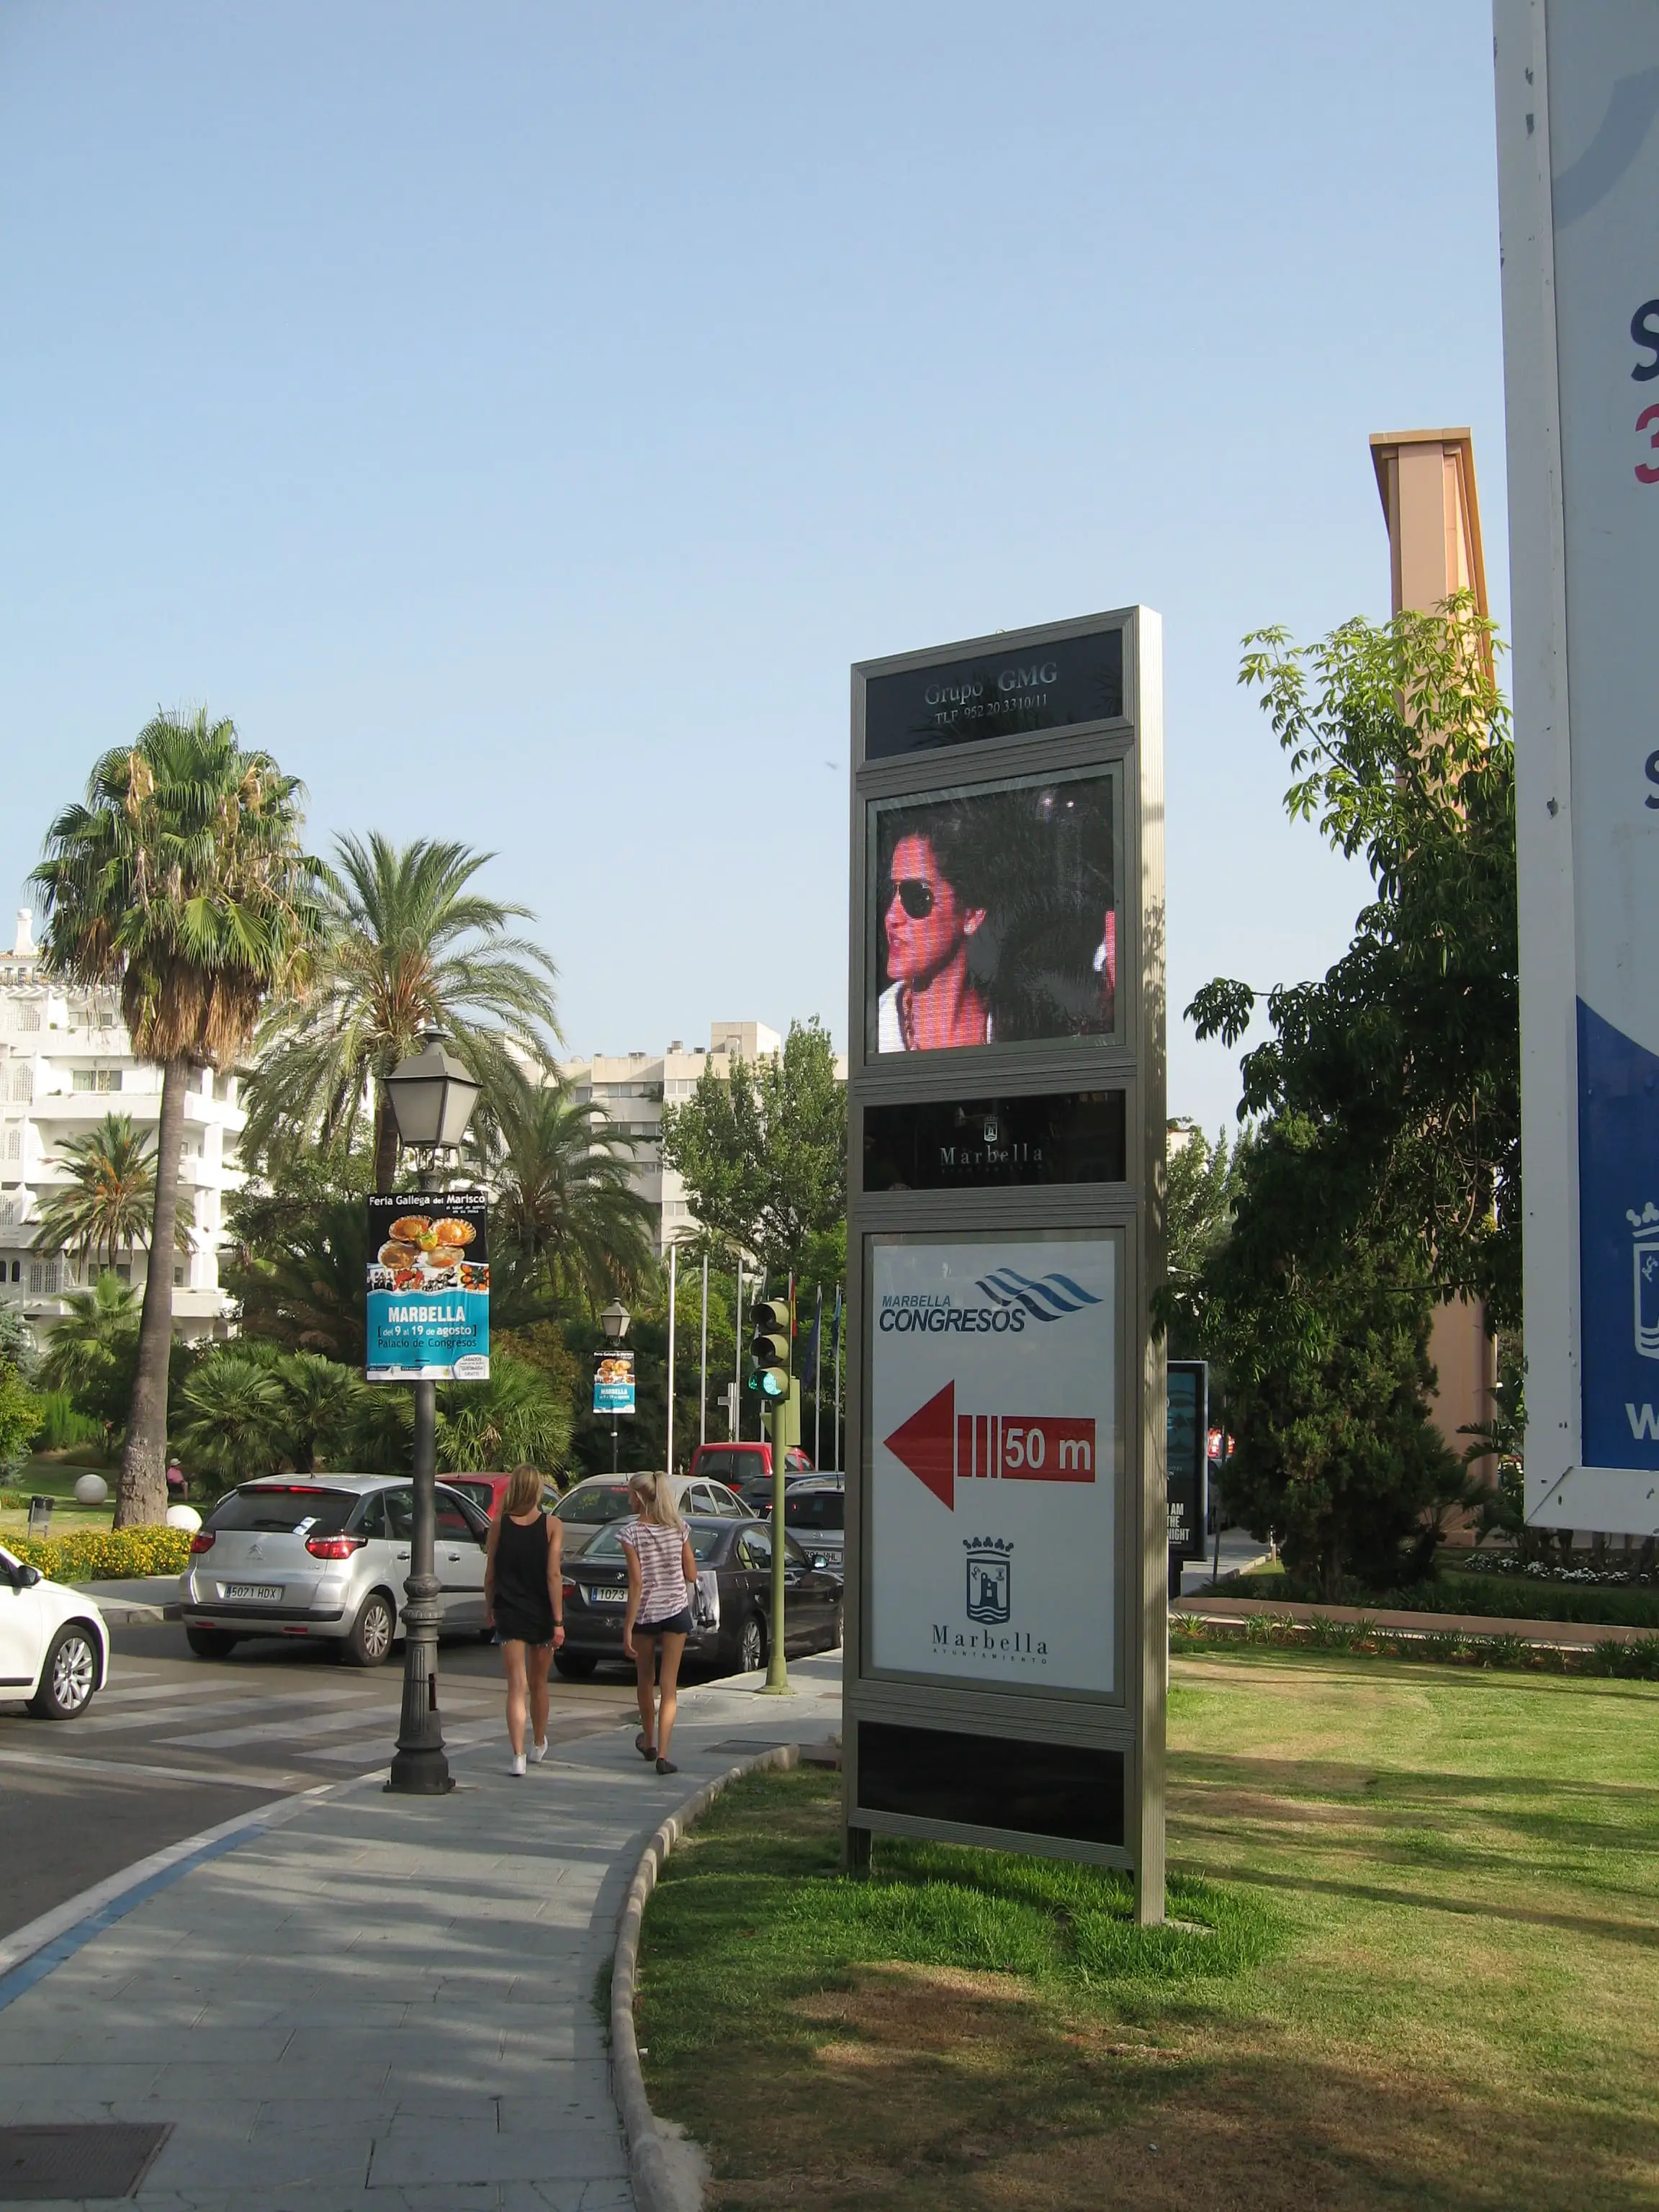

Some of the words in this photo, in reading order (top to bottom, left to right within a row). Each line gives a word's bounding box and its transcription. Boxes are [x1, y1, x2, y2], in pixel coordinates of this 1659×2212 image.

[925, 682, 984, 705] Grupo
[997, 662, 1058, 691] GMG
[940, 1143, 1043, 1165] Marbella
[369, 1196, 393, 1205] Feria
[395, 1195, 431, 1206] Gallega
[446, 1194, 485, 1204] Marisco
[882, 1295, 951, 1307] MARBELLA
[388, 1305, 466, 1323] MARBELLA
[878, 1308, 1026, 1332] CONGRESOS
[395, 1325, 401, 1336] 9
[403, 1328, 410, 1336] al
[412, 1325, 423, 1336] 19
[436, 1326, 472, 1337] agosto
[378, 1339, 410, 1348] Palacio
[413, 1339, 424, 1348] de
[428, 1339, 477, 1349] Congresos
[1005, 1428, 1046, 1469] 50
[1058, 1438, 1092, 1470] m
[1171, 1503, 1184, 1516] AM
[1166, 1516, 1180, 1527] THE
[1166, 1528, 1190, 1541] NIGHT
[232, 1586, 254, 1597] 5071
[601, 1589, 625, 1600] 1073
[932, 1624, 1048, 1655] Marbella
[933, 1648, 1047, 1664] AYUNTAMIENTO
